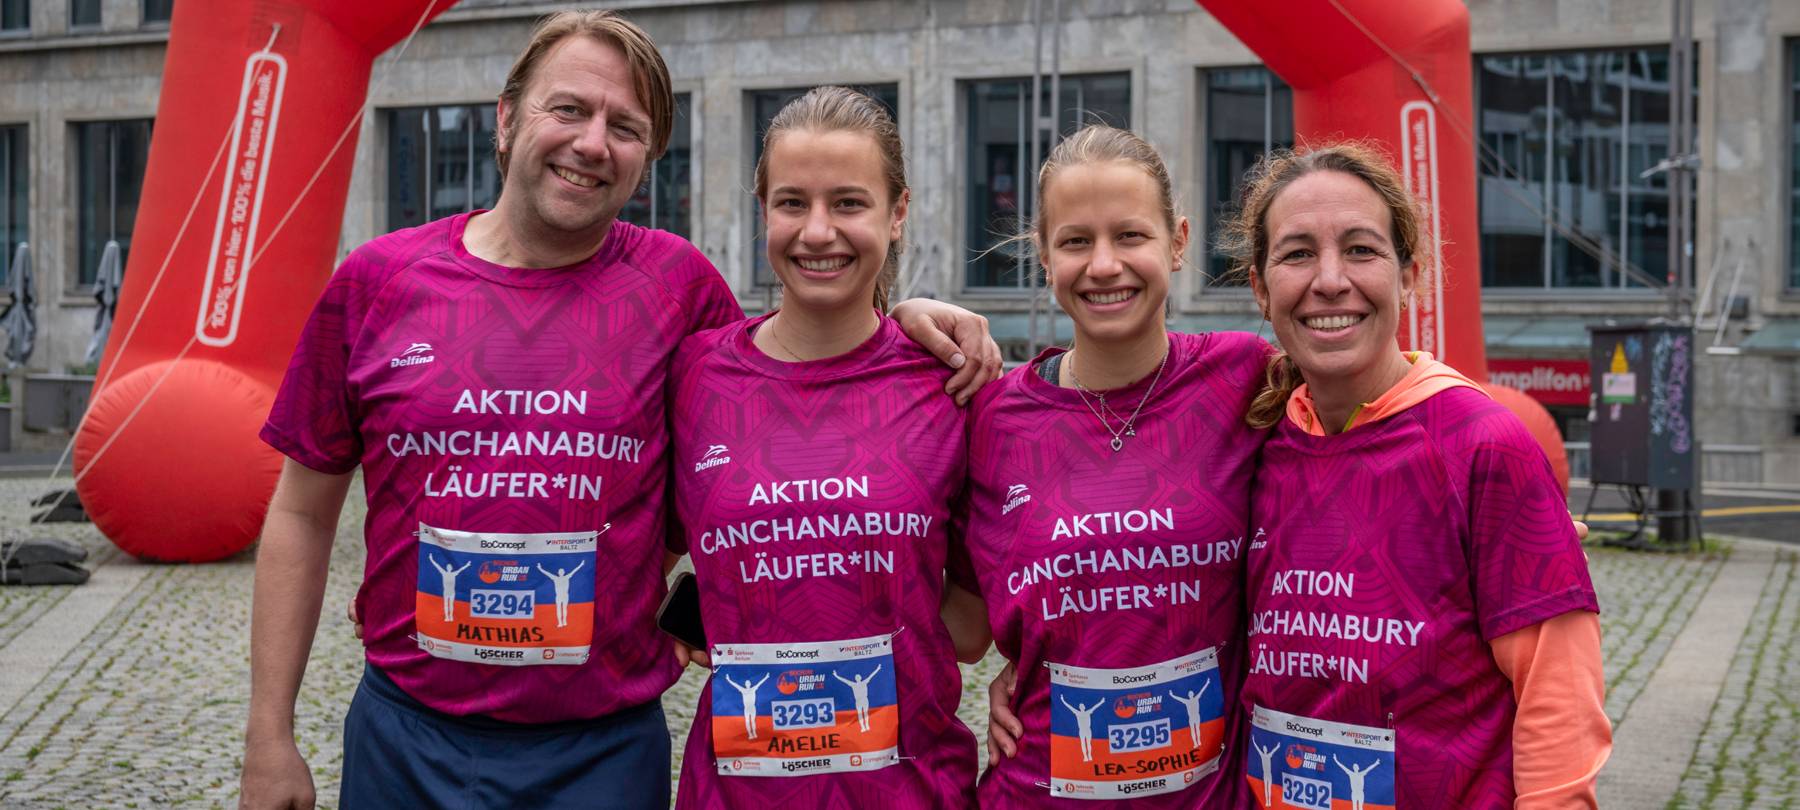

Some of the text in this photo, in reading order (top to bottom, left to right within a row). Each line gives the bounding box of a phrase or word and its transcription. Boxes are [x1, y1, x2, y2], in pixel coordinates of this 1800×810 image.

[252, 69, 273, 117] Musik.
[243, 118, 264, 158] beste
[240, 159, 256, 181] die
[231, 182, 252, 224] 100%
[222, 258, 237, 283] von
[211, 287, 232, 328] 100%
[391, 355, 434, 368] Delfina
[452, 389, 587, 415] AKTION
[387, 430, 645, 463] CANCHANABURY
[695, 455, 731, 472] Delfina
[748, 475, 869, 506] AKTION
[1002, 494, 1031, 515] Delfina
[700, 512, 933, 555] CANCHANABURY
[1051, 507, 1174, 541] AKTION
[480, 540, 526, 551] BoConcept
[502, 566, 530, 574] URBAN
[1007, 536, 1243, 596] CANCHANABURY
[500, 574, 518, 582] RUN
[1271, 569, 1354, 598] AKTION
[472, 593, 533, 616] 3294
[456, 623, 545, 643] MATHIAS
[1247, 609, 1425, 647] ANCHANABURY
[474, 648, 524, 659] LÖSCHER
[776, 649, 820, 659] BoConcept
[798, 683, 815, 691] RUN
[799, 674, 825, 683] URBAN
[1112, 672, 1157, 684] BoConcept
[1136, 704, 1152, 715] RUN
[1137, 695, 1162, 706] URBAN
[774, 702, 834, 726] 3293
[1110, 723, 1169, 749] 3295
[1286, 721, 1323, 736] BoConcept
[767, 733, 841, 753] AMELIE
[782, 759, 831, 772] LÖSCHER
[1094, 750, 1200, 776] LEA-SOPHIE
[1117, 779, 1167, 794] LÖSCHER
[1283, 778, 1330, 808] 3292
